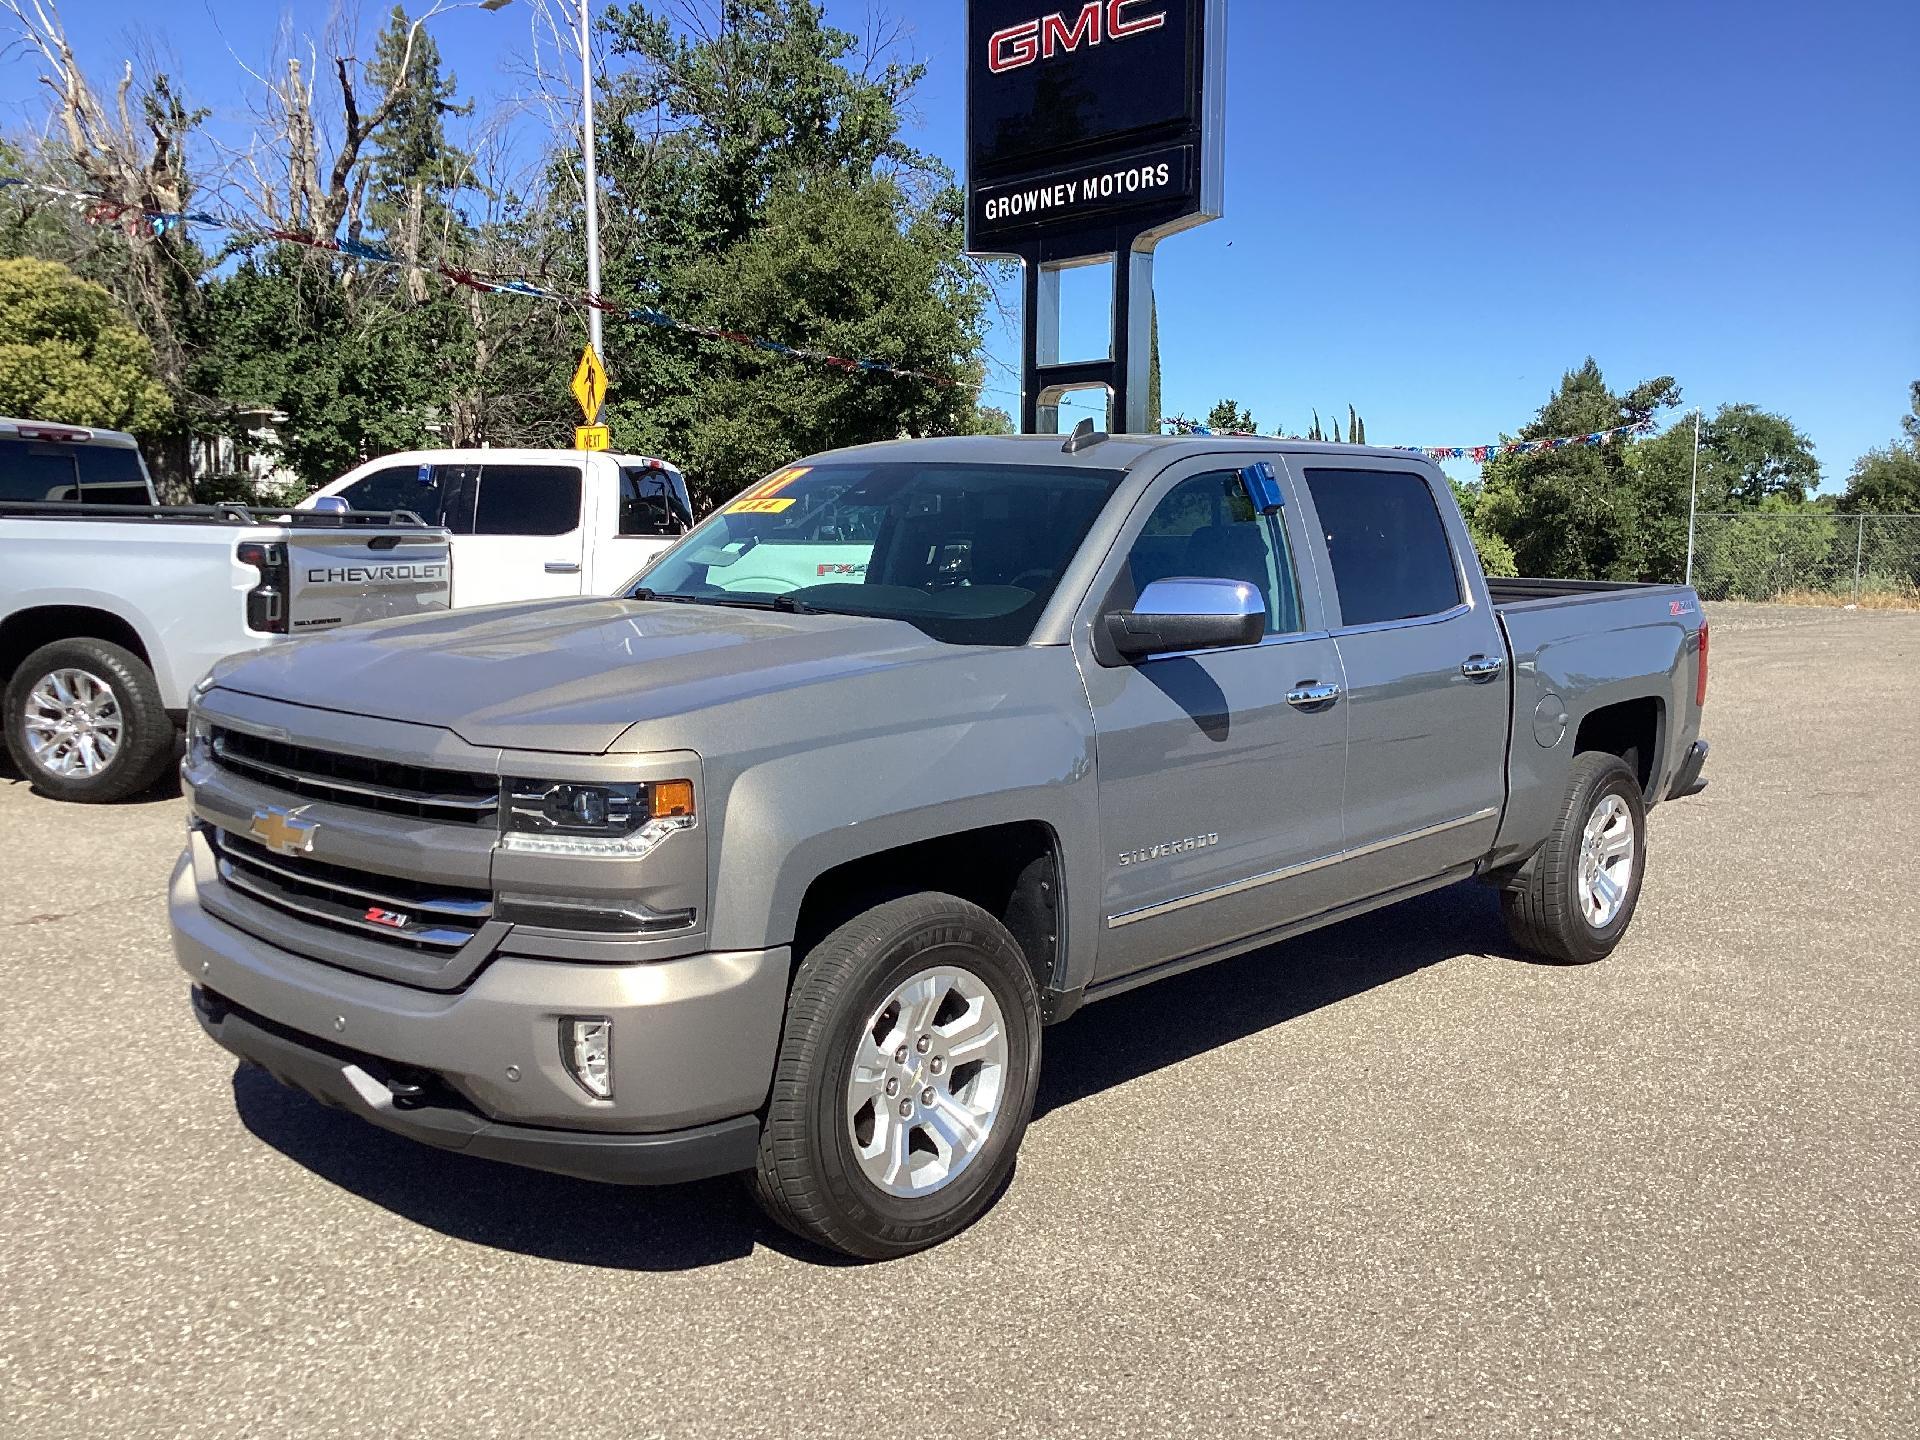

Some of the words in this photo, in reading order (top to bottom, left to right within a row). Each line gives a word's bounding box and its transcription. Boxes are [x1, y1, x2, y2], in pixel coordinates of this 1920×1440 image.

[988, 0, 1166, 73] GMC
[985, 182, 1077, 220] GROWNEY
[1083, 163, 1169, 202] MOTORS
[583, 434, 600, 448] NEXT
[308, 564, 446, 583] CHEVROLET
[1119, 832, 1219, 866] SILVERADO
[365, 907, 407, 927] Z71
